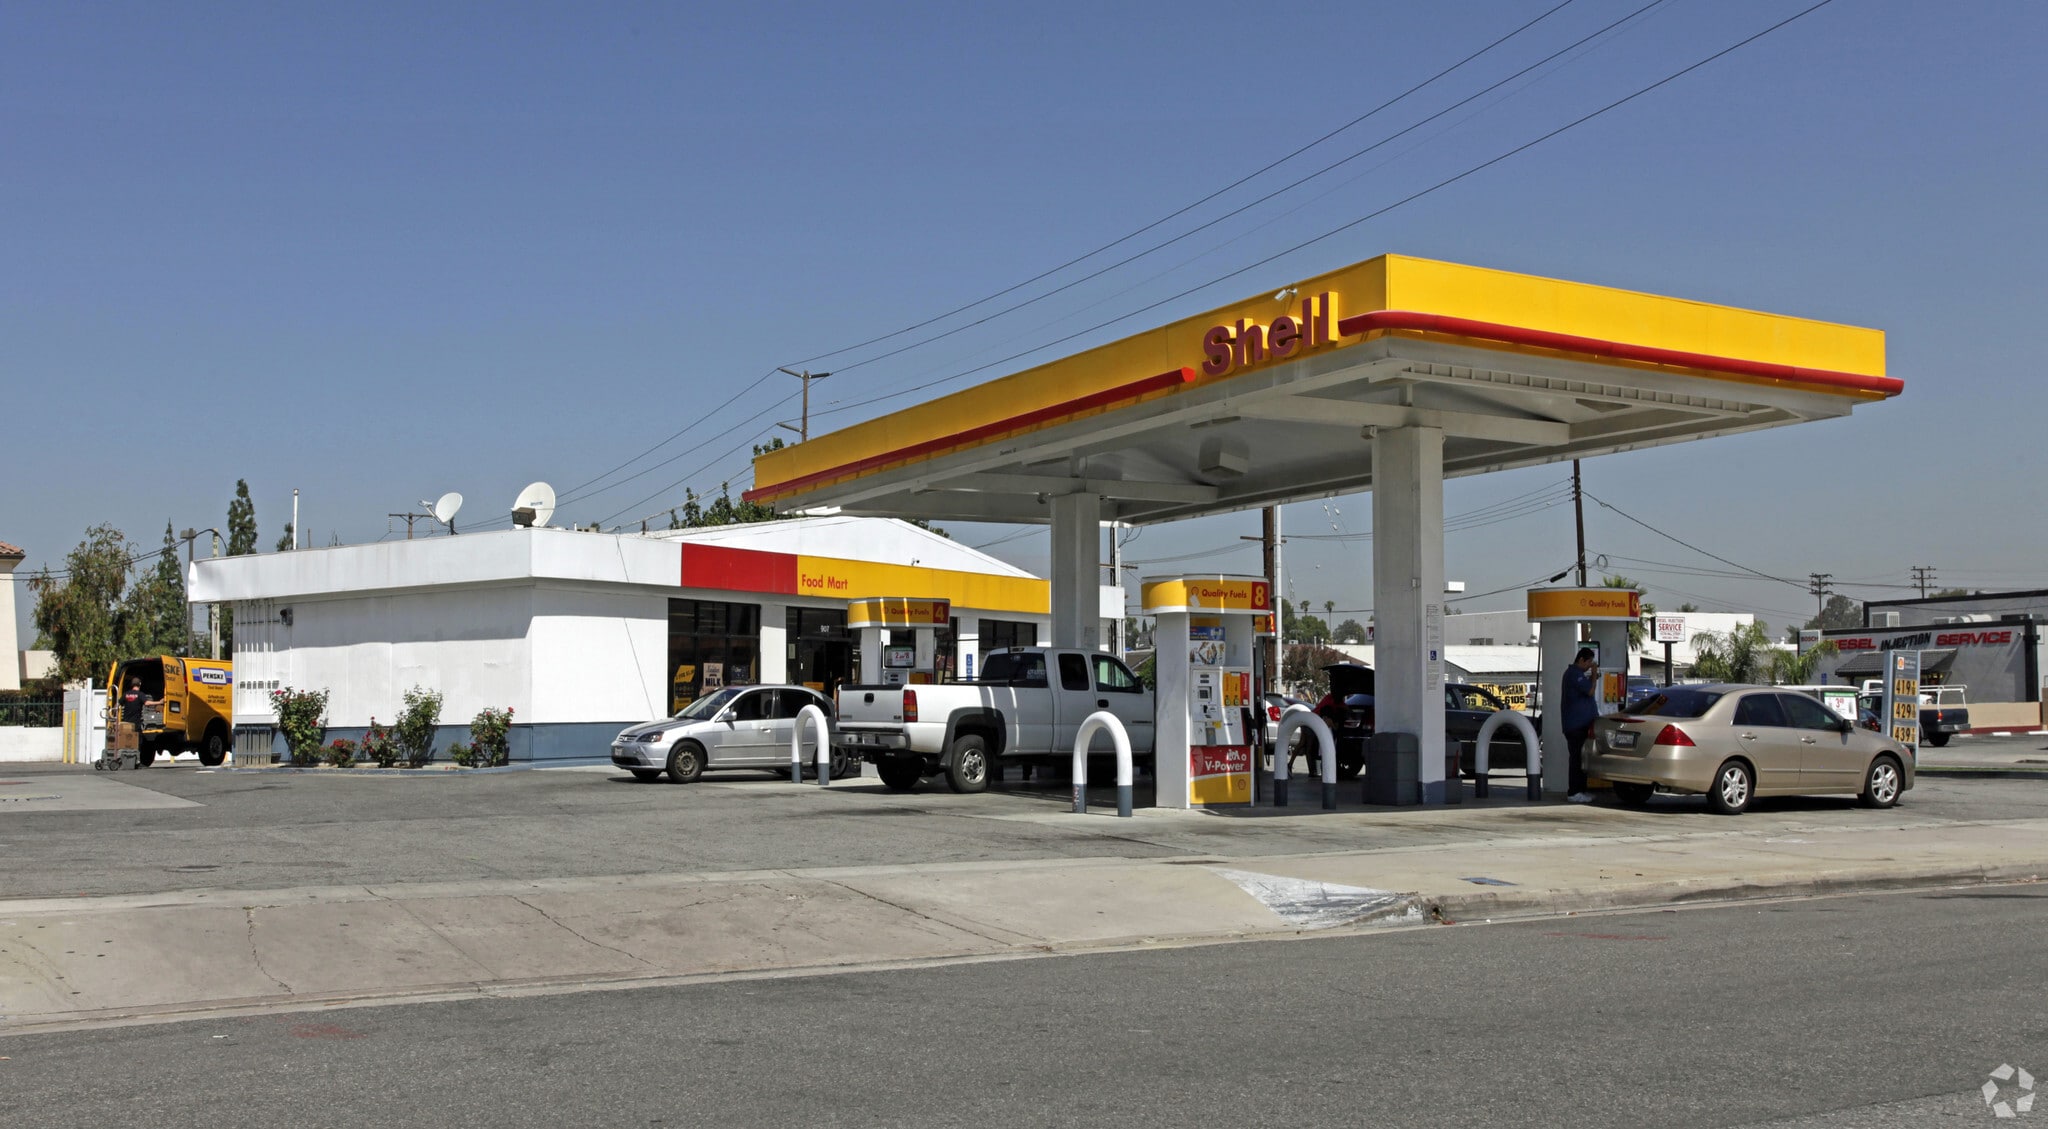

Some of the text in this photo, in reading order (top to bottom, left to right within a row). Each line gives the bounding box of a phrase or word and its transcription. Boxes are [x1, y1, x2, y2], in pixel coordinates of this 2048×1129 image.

[1202, 292, 1335, 376] Shell
[801, 574, 848, 590] Food Mart
[1201, 588, 1247, 599] Quality Fuels
[1254, 585, 1264, 606] 8
[1588, 600, 1625, 608] Quality Fuels
[891, 607, 914, 617] Quality
[935, 606, 944, 620] 4
[820, 625, 830, 633] 907
[1658, 623, 1682, 631] SERVICE
[1881, 632, 1932, 651] INJECTION
[1936, 631, 2012, 646] SERVICE
[202, 672, 224, 680] PENSKE
[705, 678, 721, 687] MILK
[1896, 679, 1911, 695] 419
[1895, 702, 1911, 719] 429
[1894, 727, 1911, 742] 439
[1205, 760, 1244, 771] V-Power
